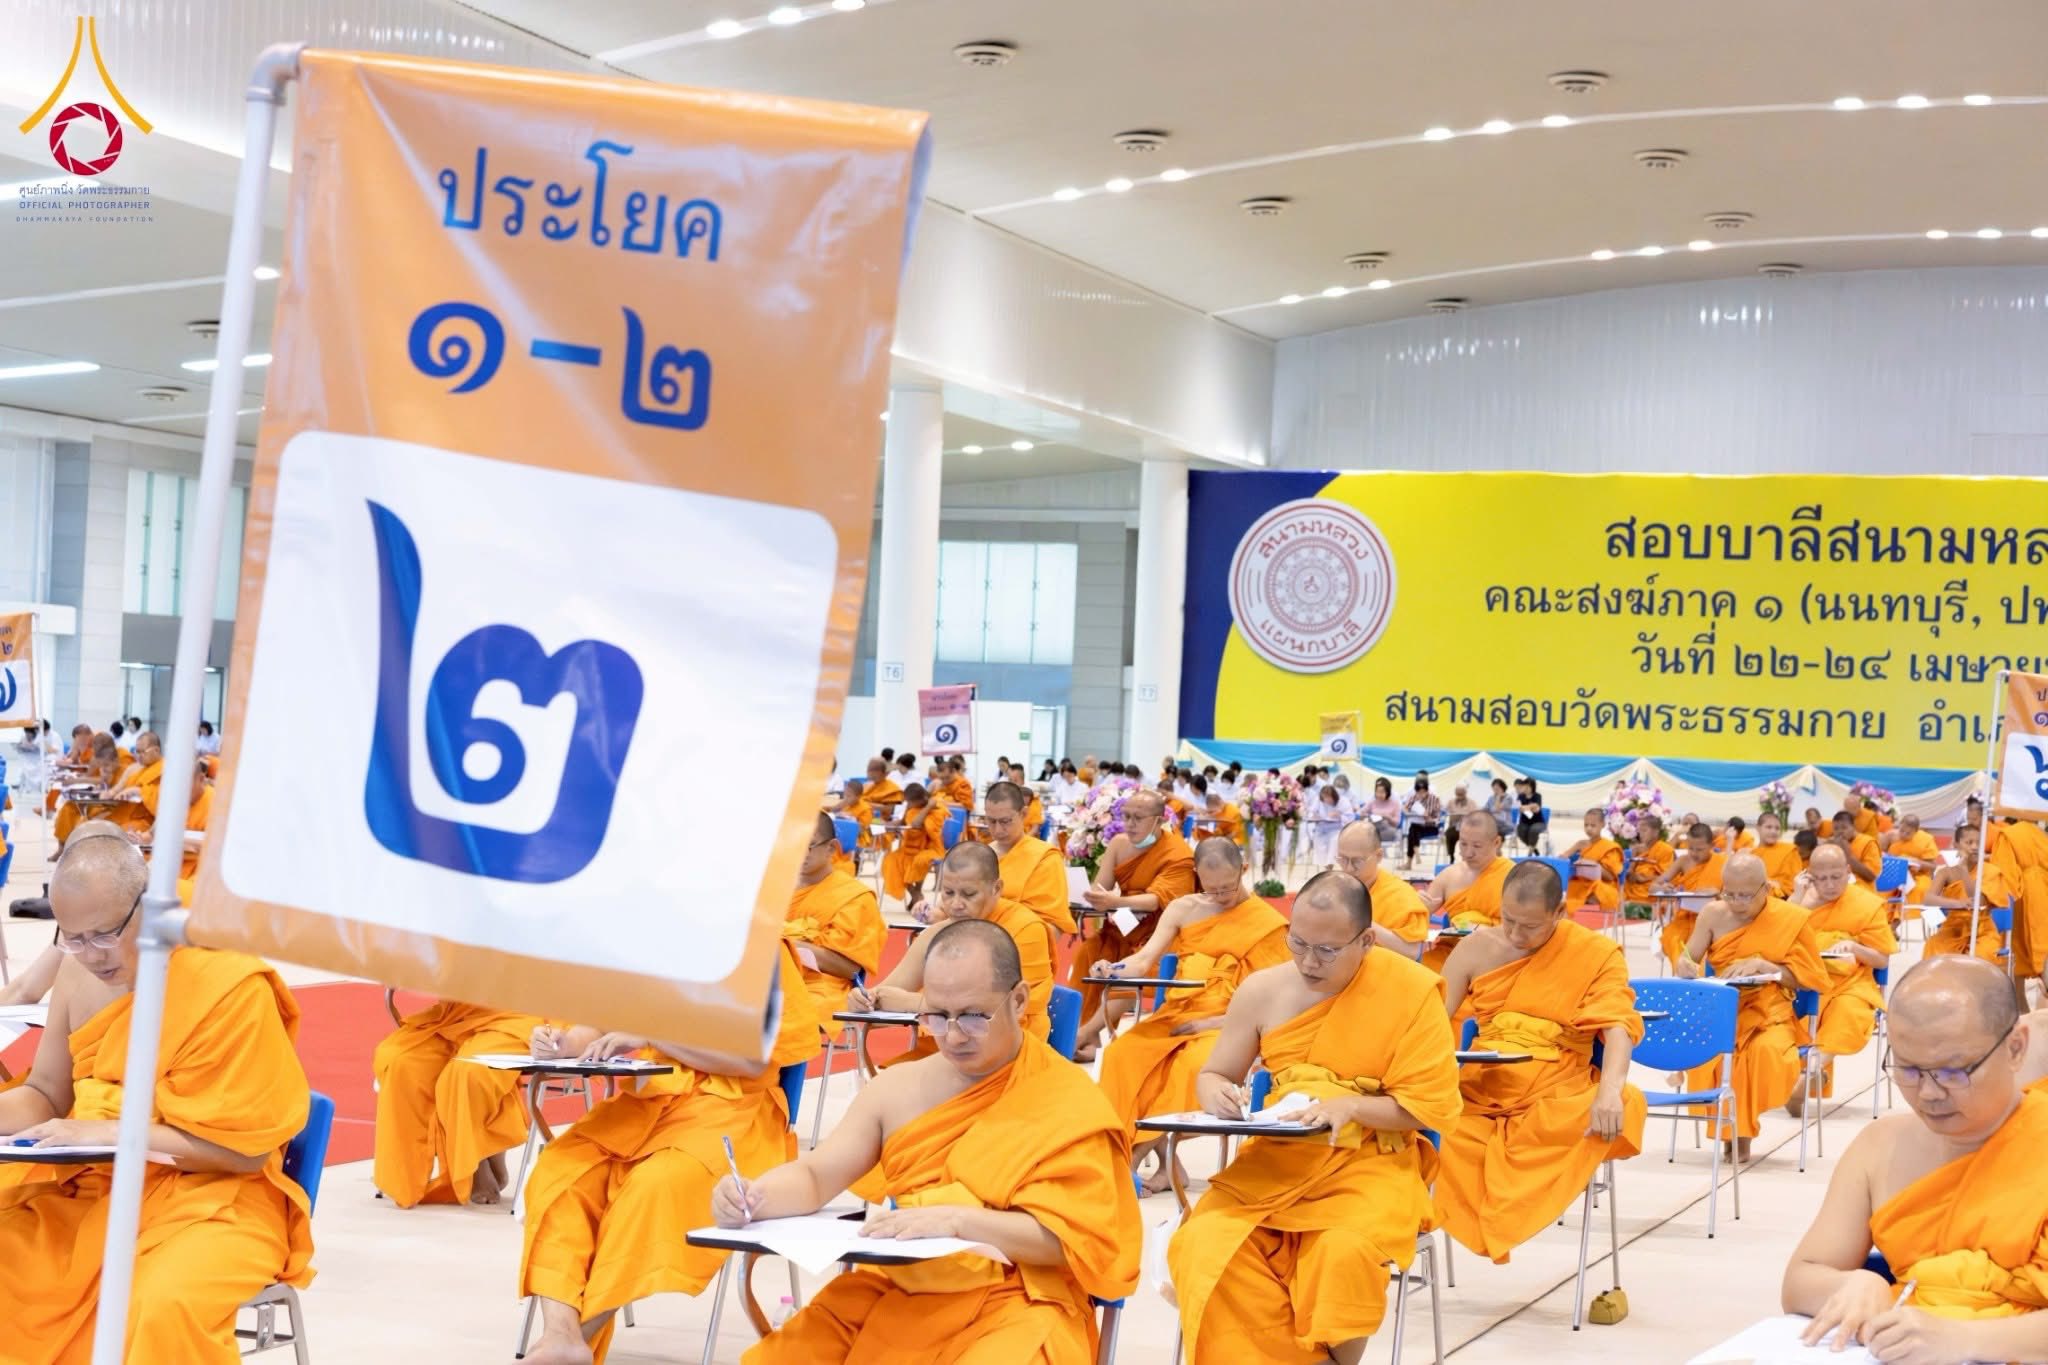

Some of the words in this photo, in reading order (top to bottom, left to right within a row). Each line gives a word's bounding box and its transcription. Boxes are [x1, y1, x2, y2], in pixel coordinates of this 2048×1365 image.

[438, 139, 724, 262] ประโยค
[408, 302, 711, 430] ๑-๒
[1258, 519, 1369, 561] สนามหลวง
[1485, 573, 1737, 619] คณะสงฆ์ภาค
[1755, 596, 1783, 622] ๑
[1800, 579, 1981, 639] (นนทบุรี,
[1260, 618, 1362, 654] แผนกบาลี
[1631, 621, 1716, 676] วันที่
[1734, 644, 1892, 681] ๒๒-๒๔
[1909, 653, 2048, 683] เมษาย
[362, 498, 645, 885] ๒
[885, 666, 900, 679] T6
[935, 723, 958, 745] ๑
[1385, 687, 1886, 740] สนามสอบวัดพระธรรมกาย
[1331, 738, 1348, 754] ๑
